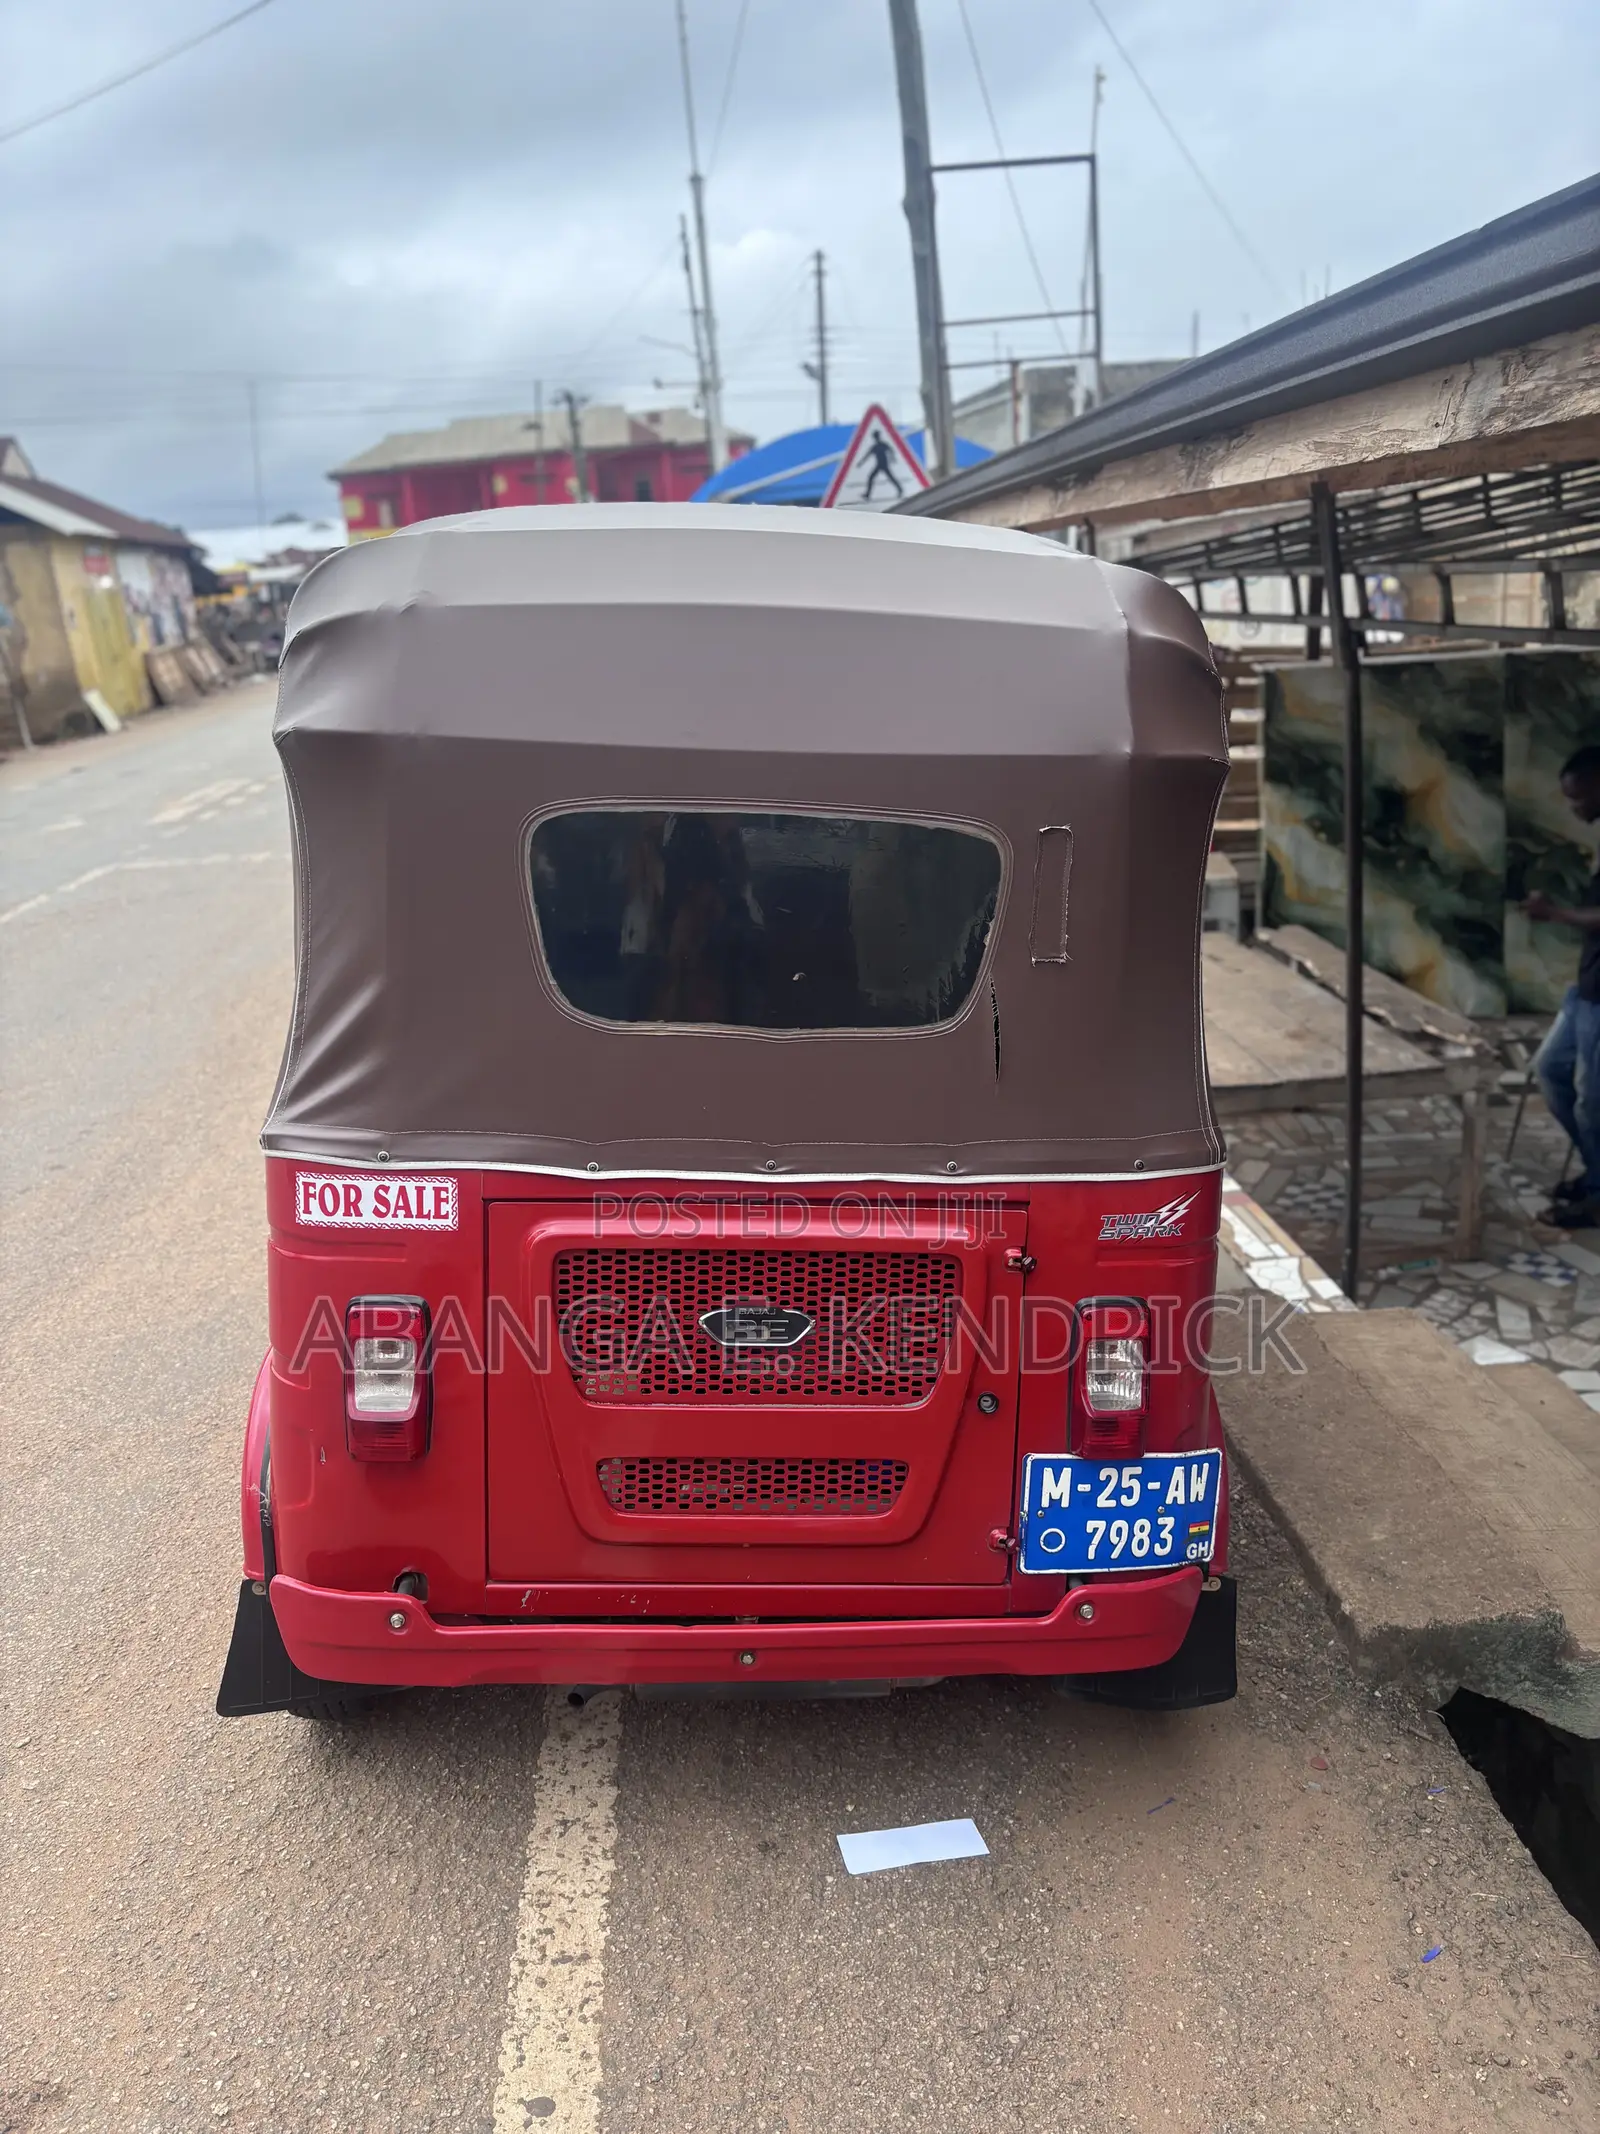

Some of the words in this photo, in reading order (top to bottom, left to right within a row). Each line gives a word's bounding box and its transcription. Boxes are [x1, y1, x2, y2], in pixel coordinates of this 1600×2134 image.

[302, 1181, 363, 1217] FOR
[372, 1184, 449, 1220] SALE
[1098, 1223, 1185, 1240] SPARK
[738, 1307, 777, 1315] BAJAJ
[725, 1319, 789, 1339] RE
[1041, 1462, 1209, 1508] M-25-AW
[1086, 1516, 1175, 1560] 7983
[1186, 1541, 1209, 1560] GH
